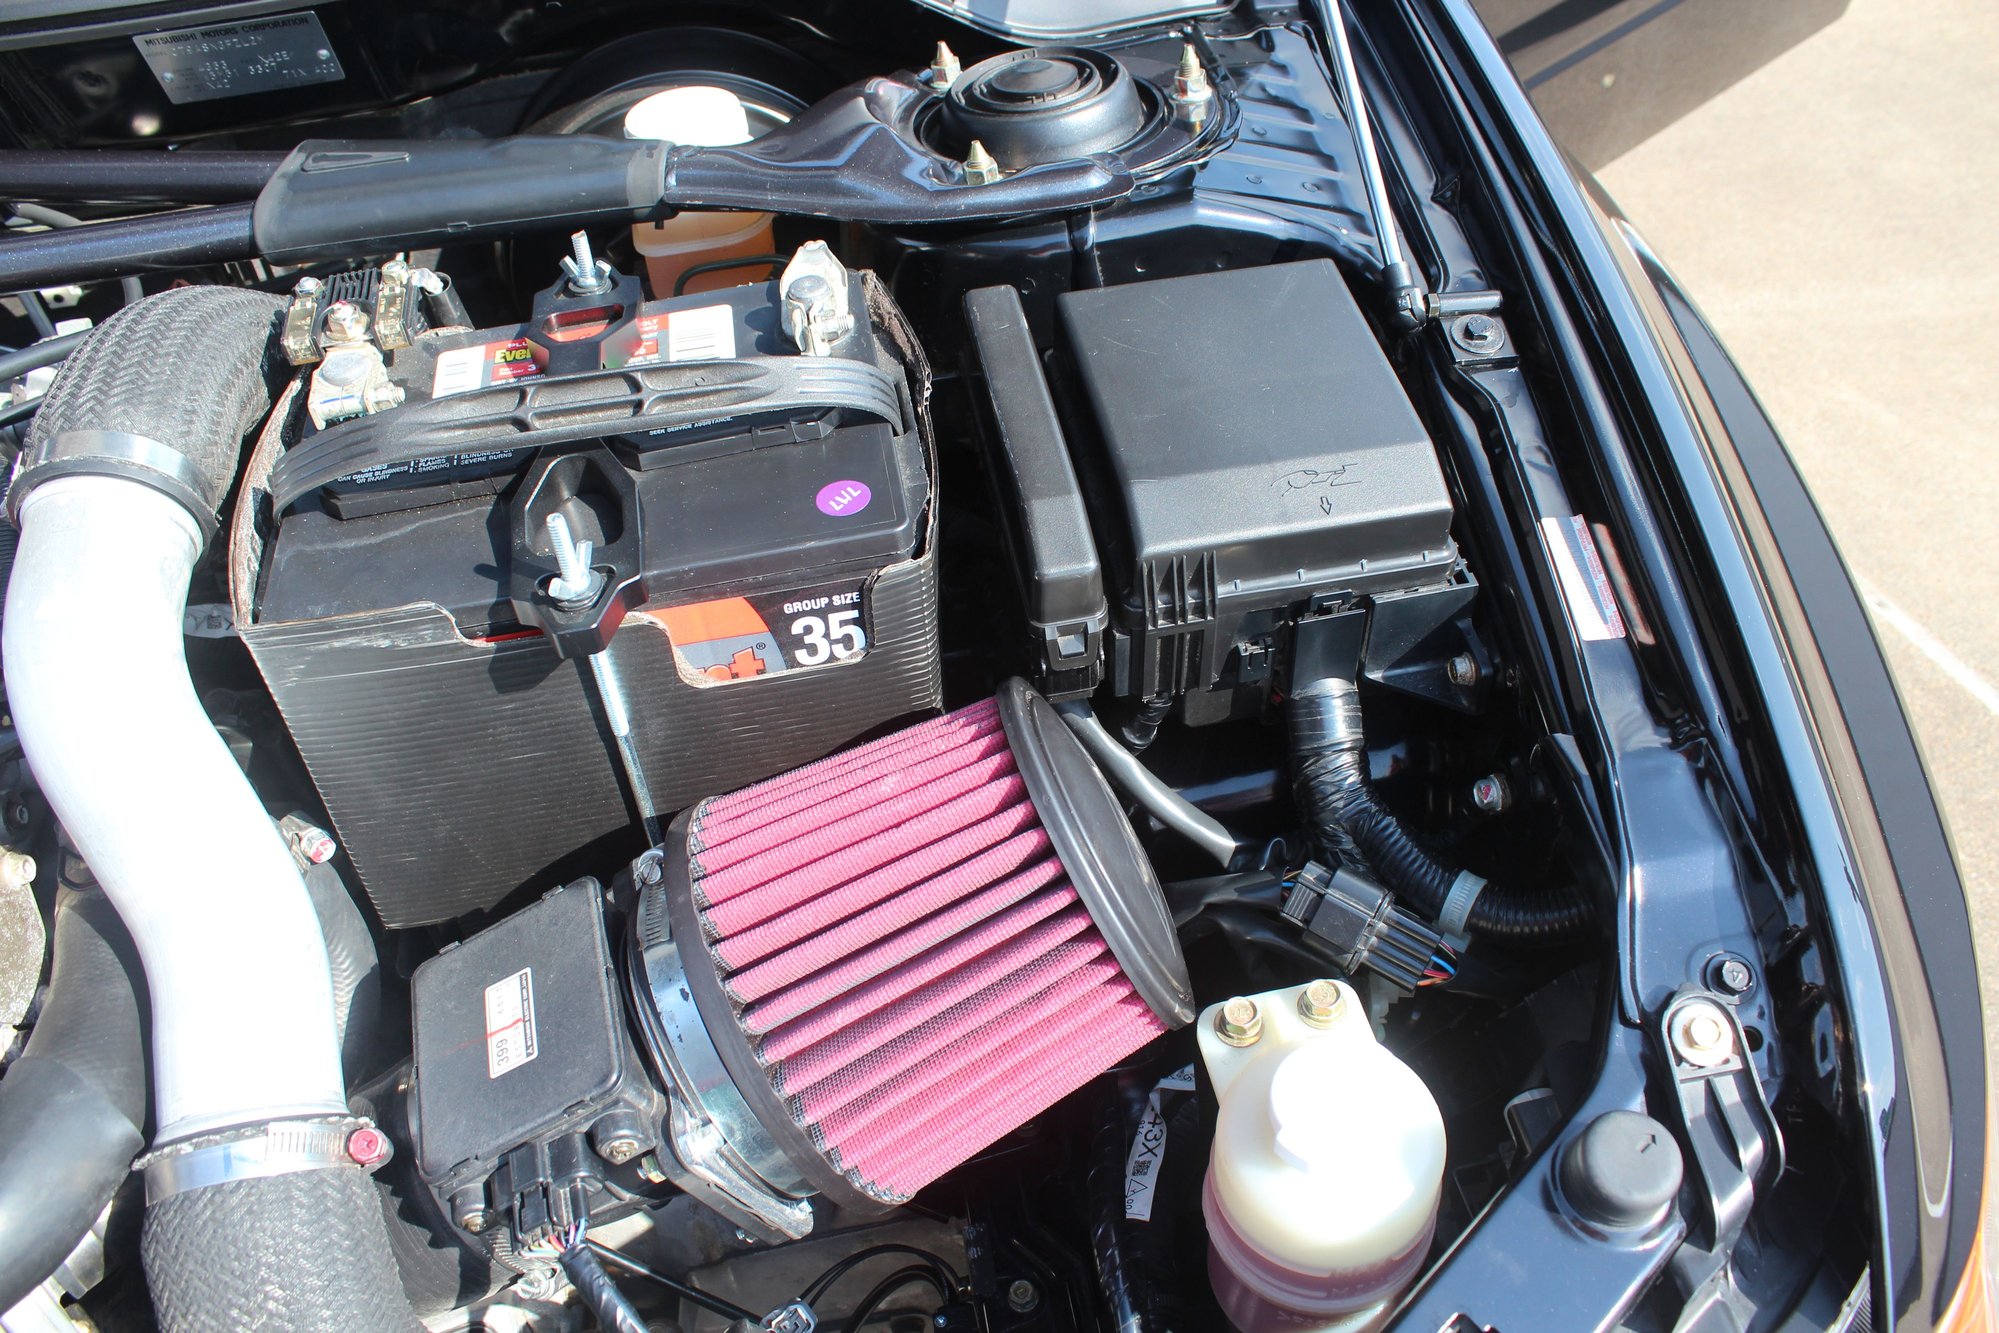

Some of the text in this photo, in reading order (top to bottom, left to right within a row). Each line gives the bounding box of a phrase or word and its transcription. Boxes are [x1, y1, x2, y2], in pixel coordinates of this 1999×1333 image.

[144, 17, 309, 48] MITSUBISHI MOTORS CORPORATION
[648, 428, 666, 436] SEEK
[666, 422, 693, 433] SERVICE
[418, 458, 447, 468] FLAMES
[460, 452, 513, 465] SEVERE BURNS
[337, 465, 409, 483] CAN CAUSE BLINDNESS
[417, 463, 450, 473] SMOKING
[367, 474, 390, 484] INJURY
[783, 591, 861, 615] GROUP SIZE
[791, 609, 867, 666] 35
[495, 1038, 510, 1066] 399
